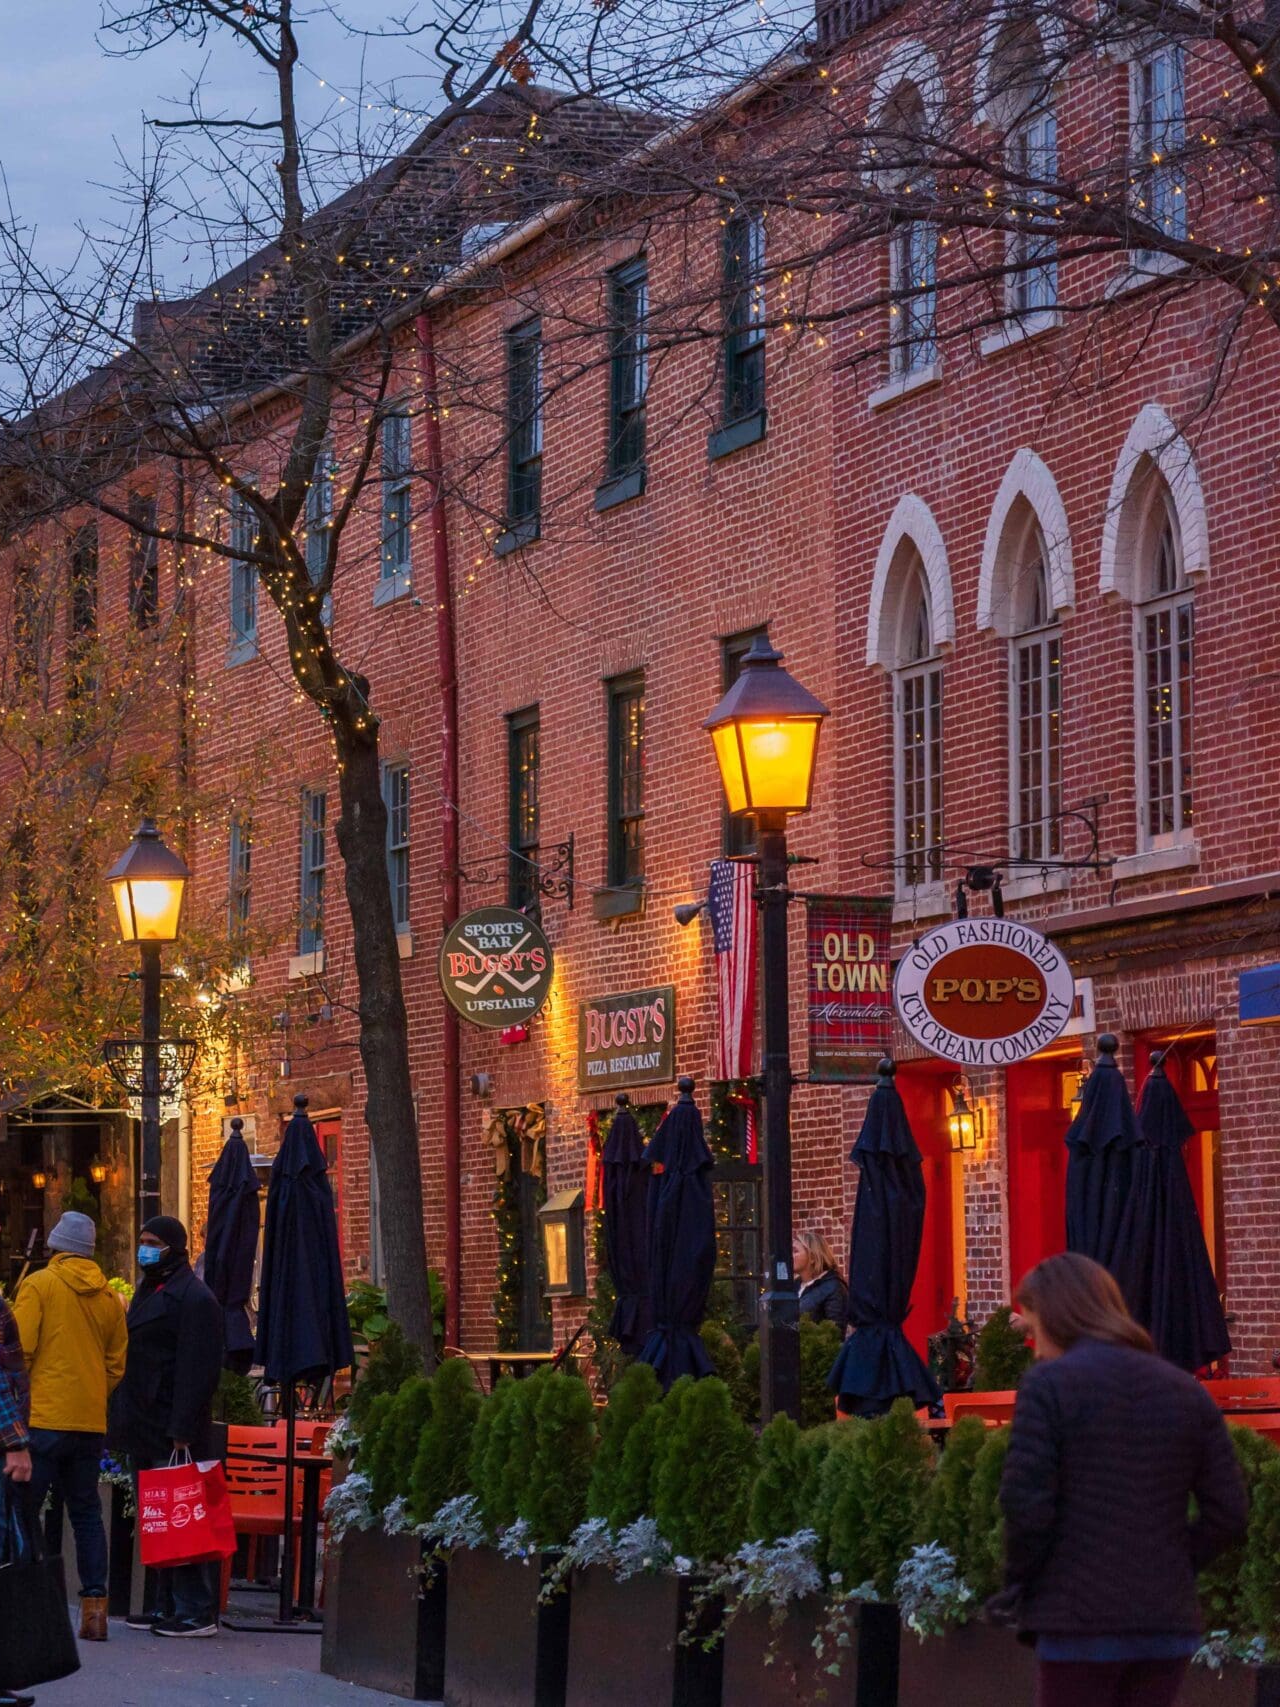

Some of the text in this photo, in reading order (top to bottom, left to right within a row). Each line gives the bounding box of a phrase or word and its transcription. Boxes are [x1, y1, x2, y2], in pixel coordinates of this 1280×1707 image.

[464, 922, 524, 937] SPORTS
[477, 936, 513, 949] BAR
[823, 932, 875, 962] OLD
[911, 921, 1060, 974] OLD FASHIONED
[447, 947, 547, 977] BUGSY'S
[812, 962, 887, 993] TOWN
[931, 977, 1042, 1003] POP'S
[465, 997, 536, 1012] UPSTAIRS
[809, 1001, 892, 1026] Alexandria
[584, 997, 666, 1053] BUGSY'S
[900, 990, 1069, 1064] ICE CREAM COMPANY
[587, 1052, 661, 1076] PIZZA RESTAURANT
